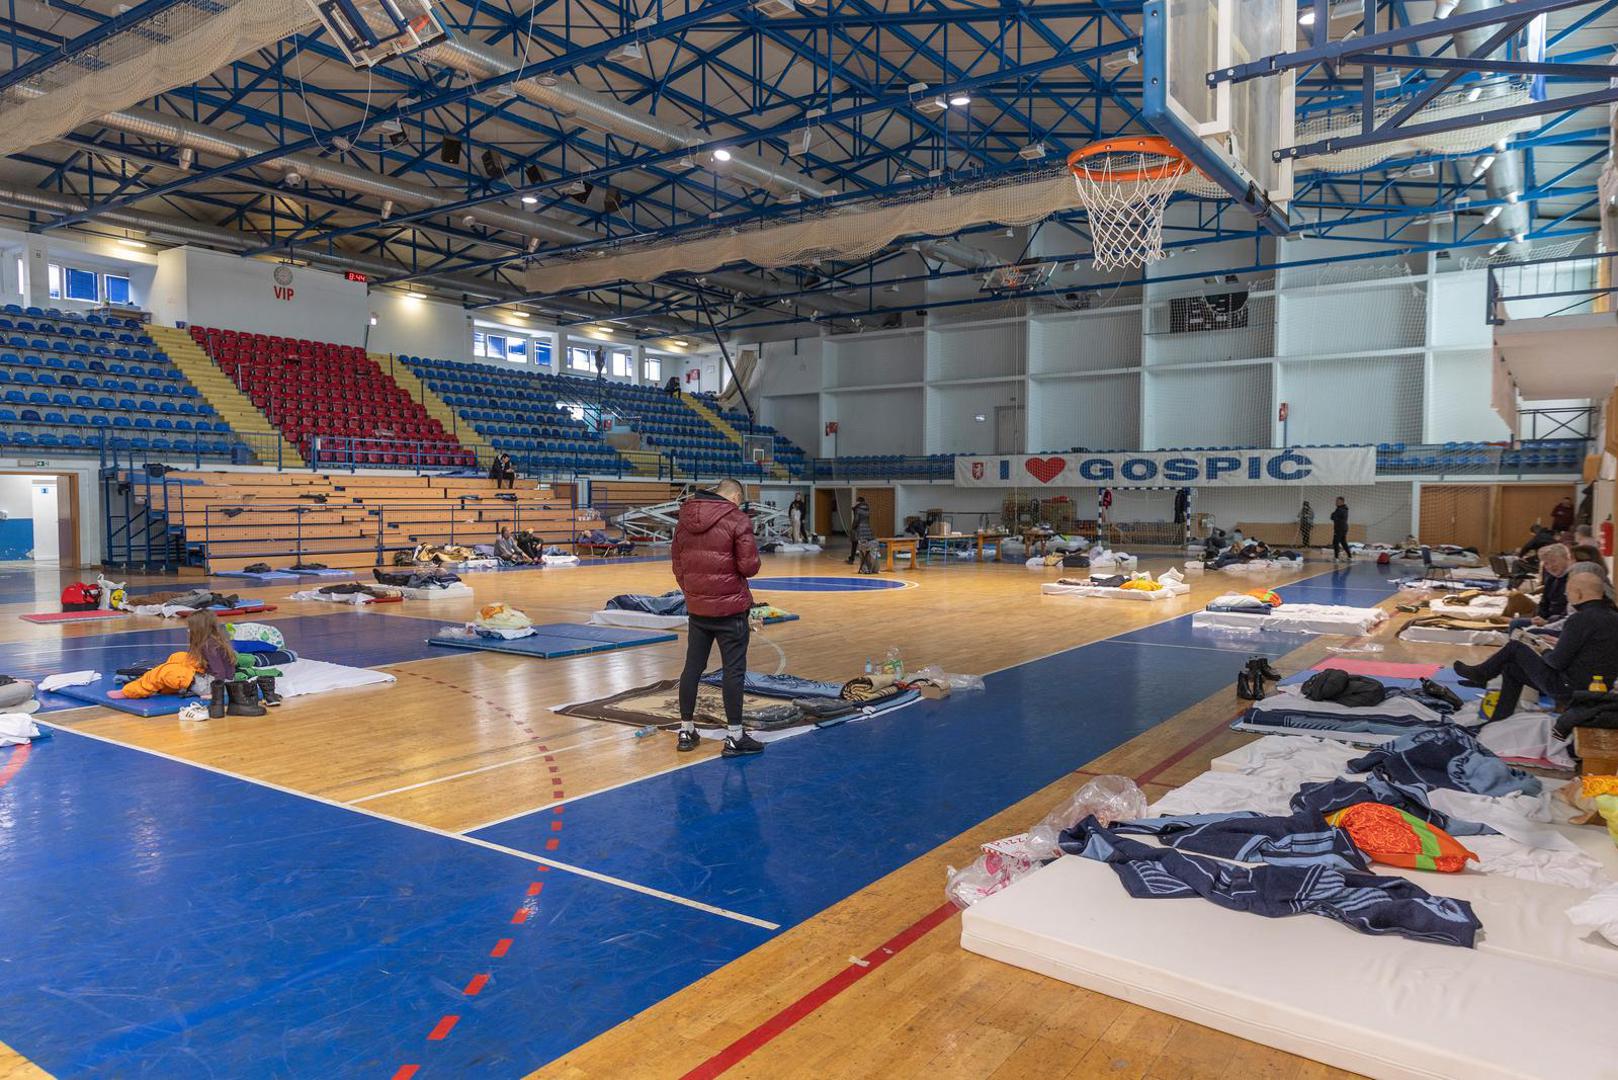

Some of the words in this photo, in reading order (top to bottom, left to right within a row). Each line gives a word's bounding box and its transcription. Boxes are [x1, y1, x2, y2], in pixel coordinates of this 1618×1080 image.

[273, 286, 295, 301] VIP
[999, 460, 1009, 481] I
[1080, 448, 1312, 482] GOSPIĆ
